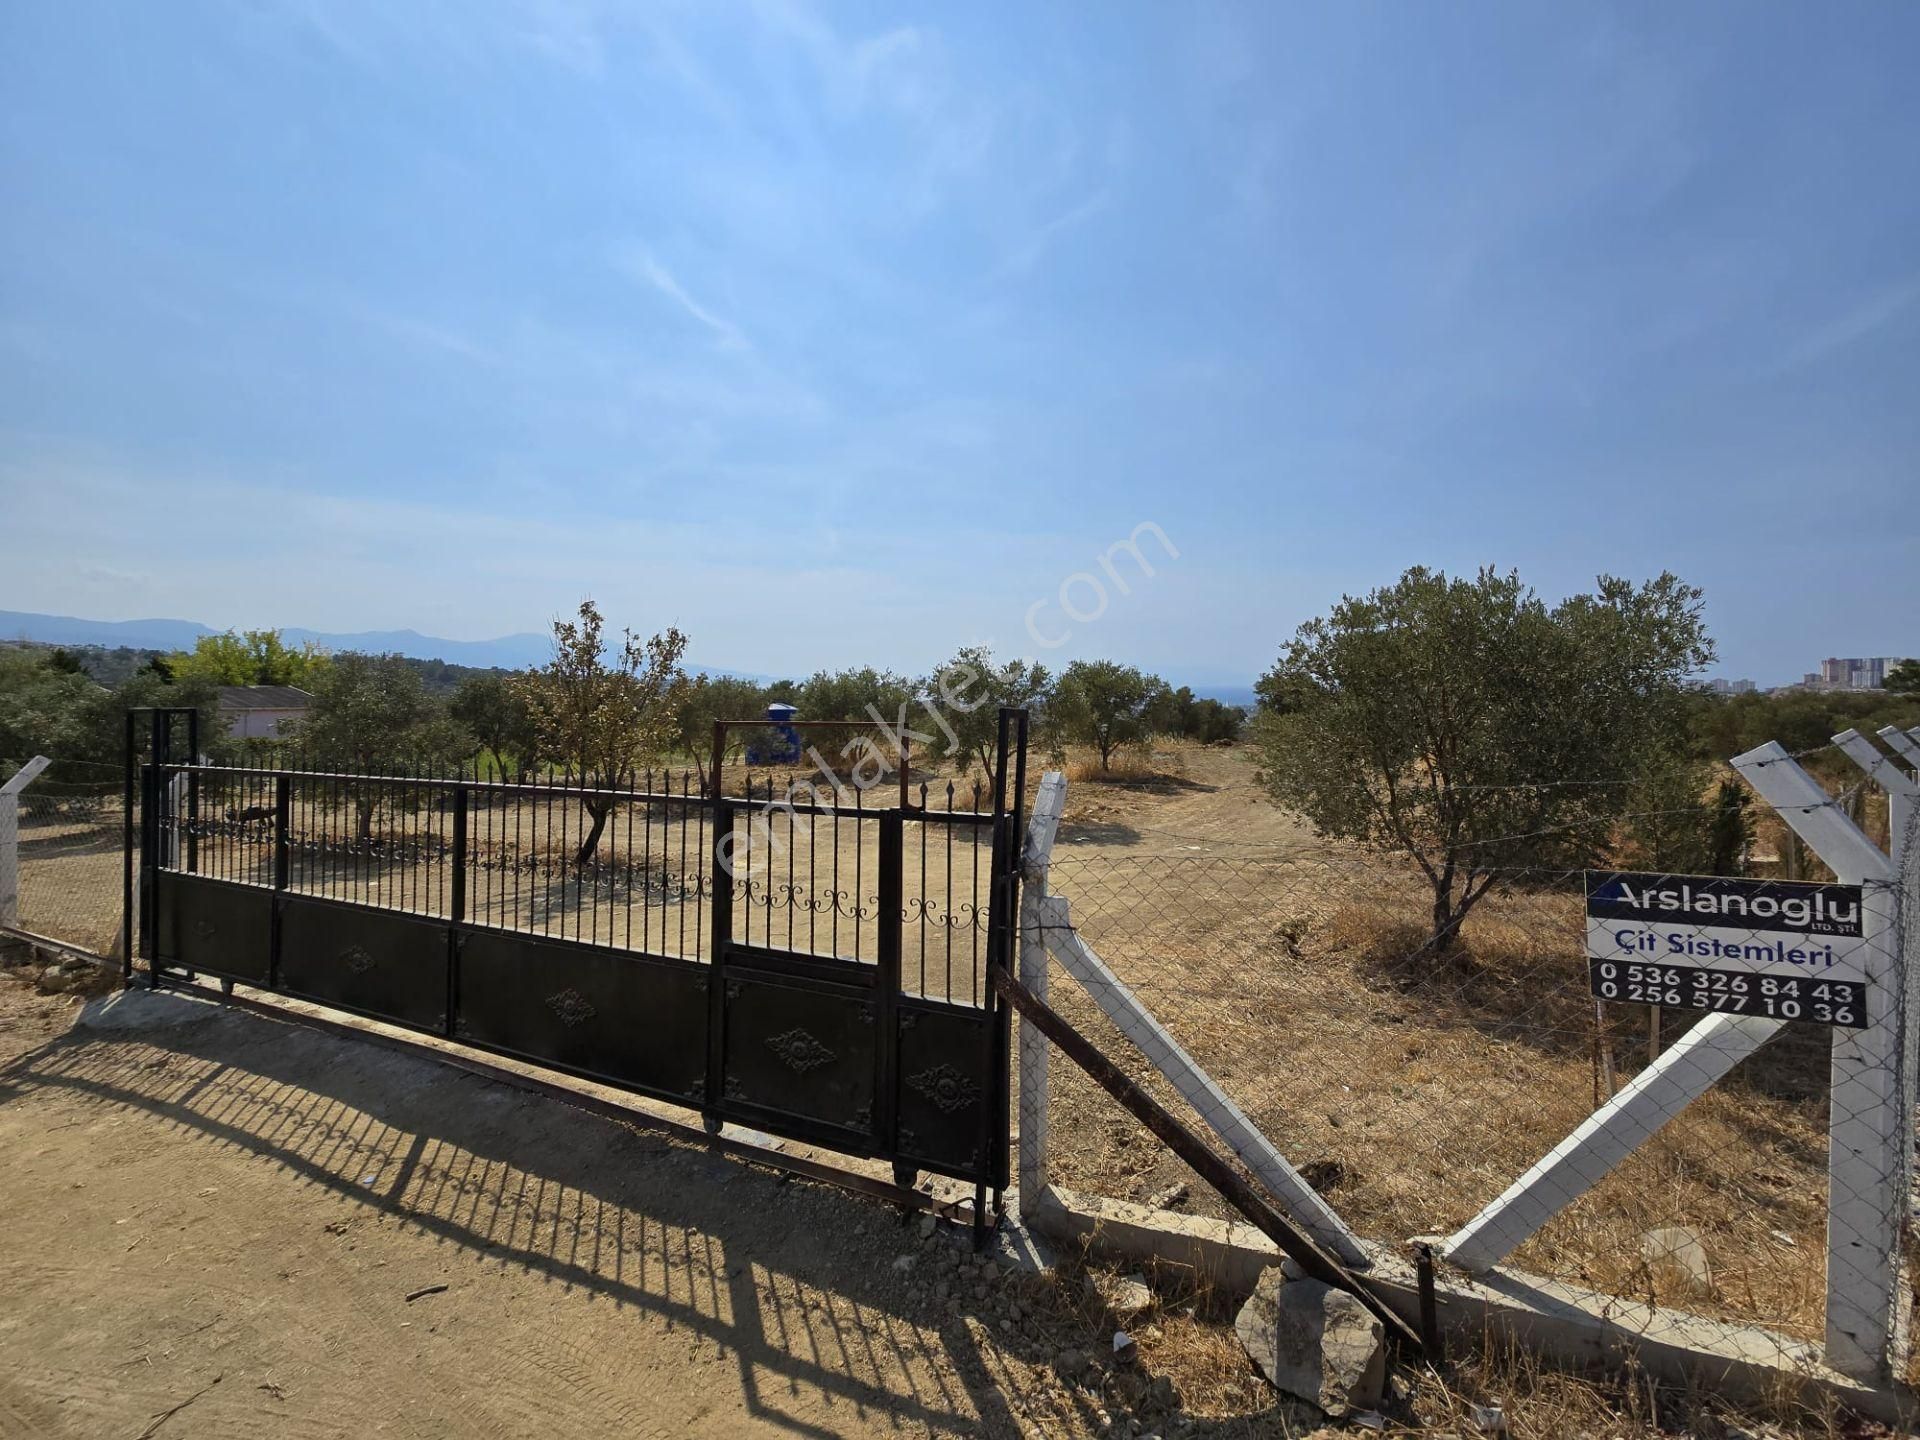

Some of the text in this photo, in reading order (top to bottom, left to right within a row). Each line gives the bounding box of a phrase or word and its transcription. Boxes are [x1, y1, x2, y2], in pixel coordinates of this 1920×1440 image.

[1616, 882, 1858, 927] Arslanoglu
[1811, 922, 1835, 931] LTD.
[1615, 929, 1833, 967] Çit Sistemleri
[1600, 962, 1853, 1003] 0 536 326 84 43
[1600, 981, 1855, 1024] 0 256 577 10 36
